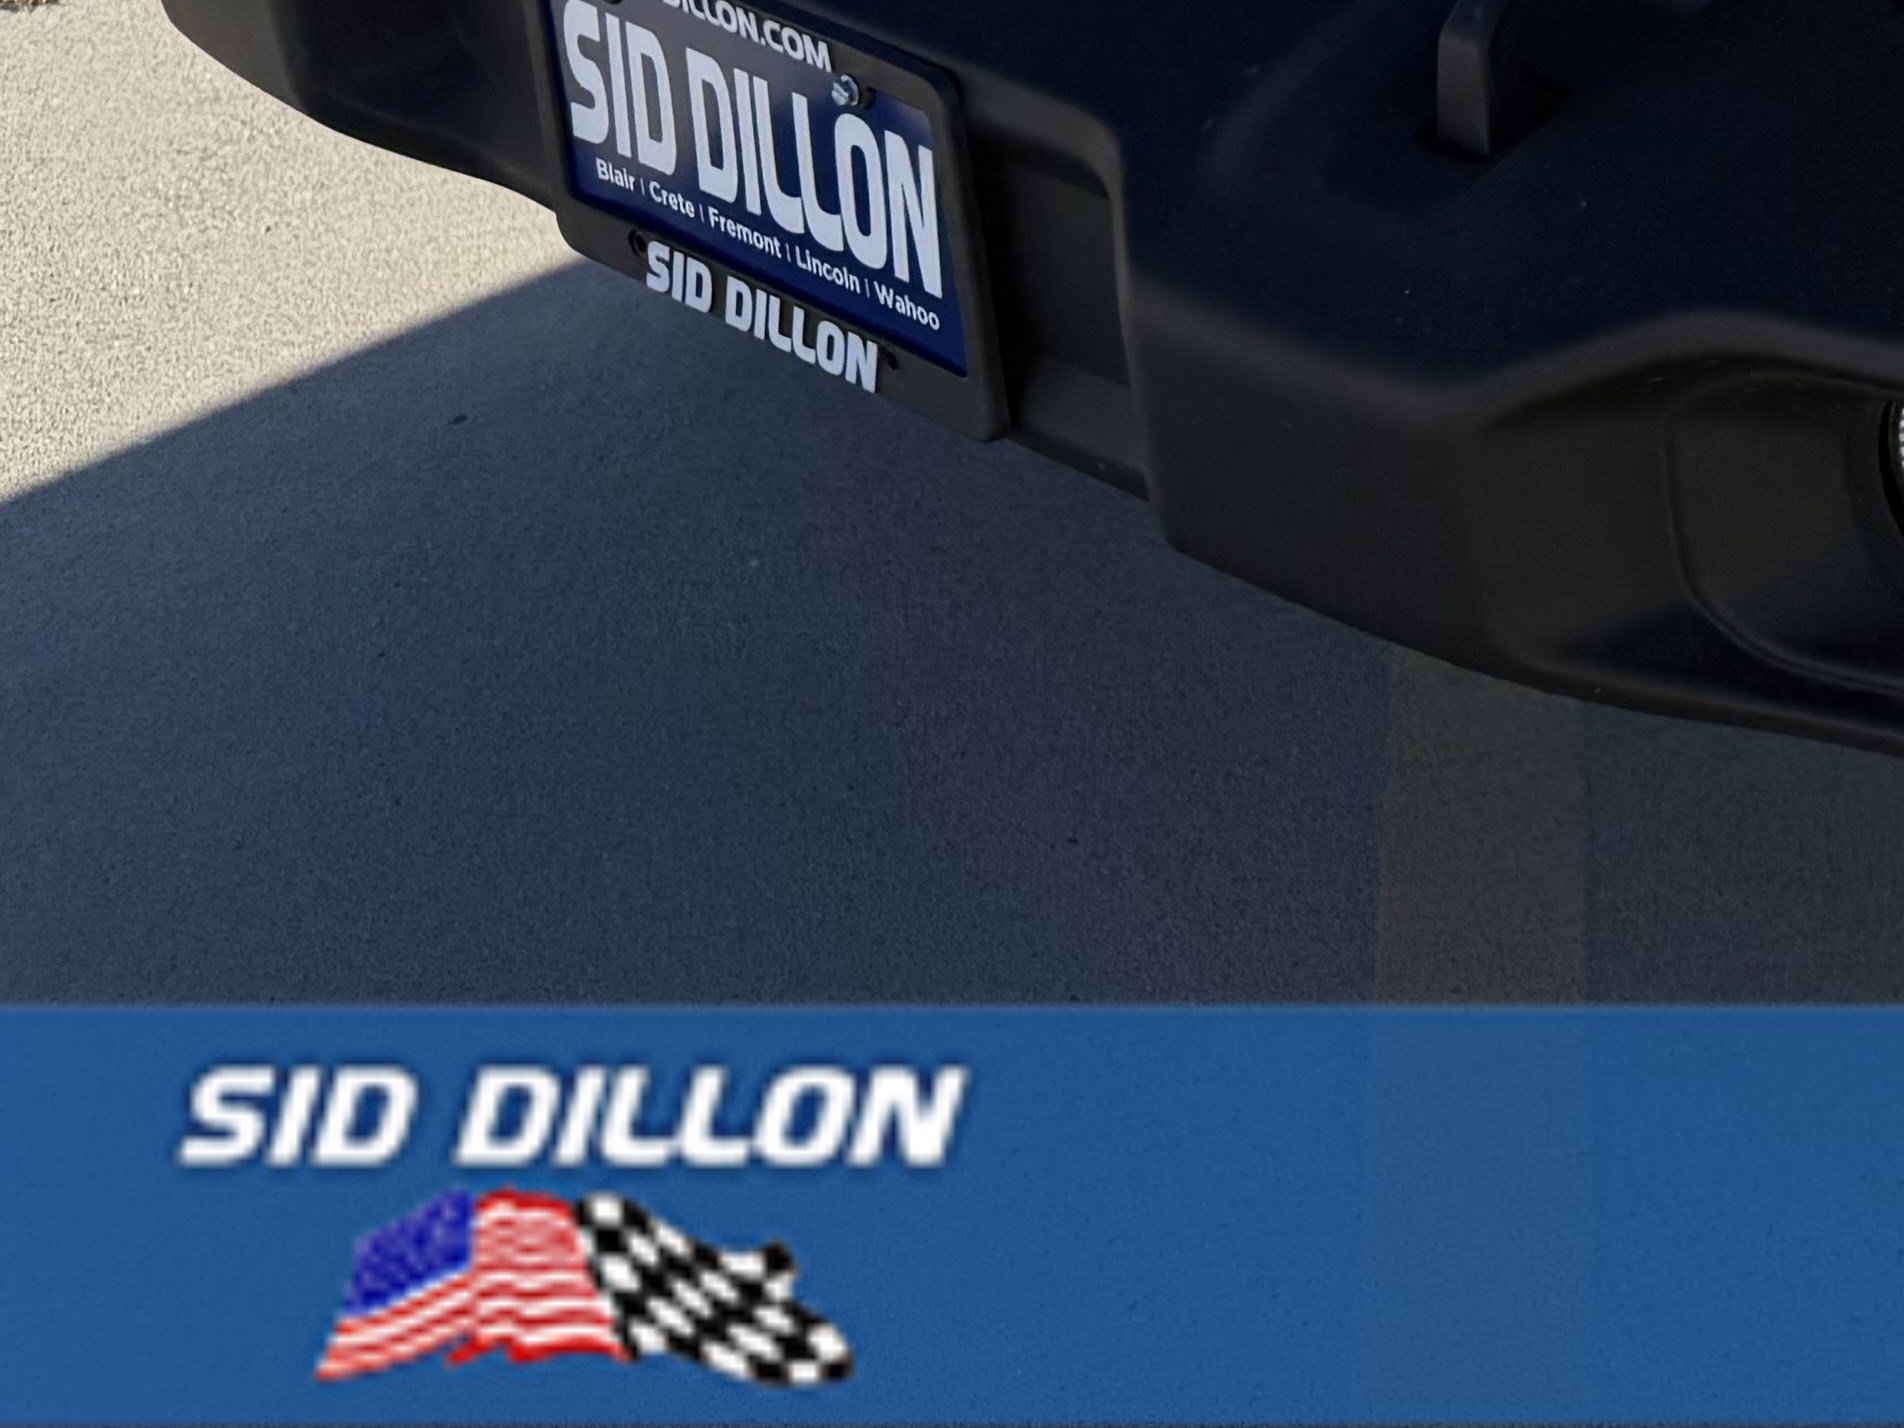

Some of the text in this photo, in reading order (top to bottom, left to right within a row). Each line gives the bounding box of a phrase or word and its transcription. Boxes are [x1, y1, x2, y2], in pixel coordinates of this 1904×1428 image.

[595, 157, 941, 331] Blair Crete Fremont Lincoln Wahoo
[685, 46, 943, 299] DILLON
[645, 240, 878, 394] SID DILLON
